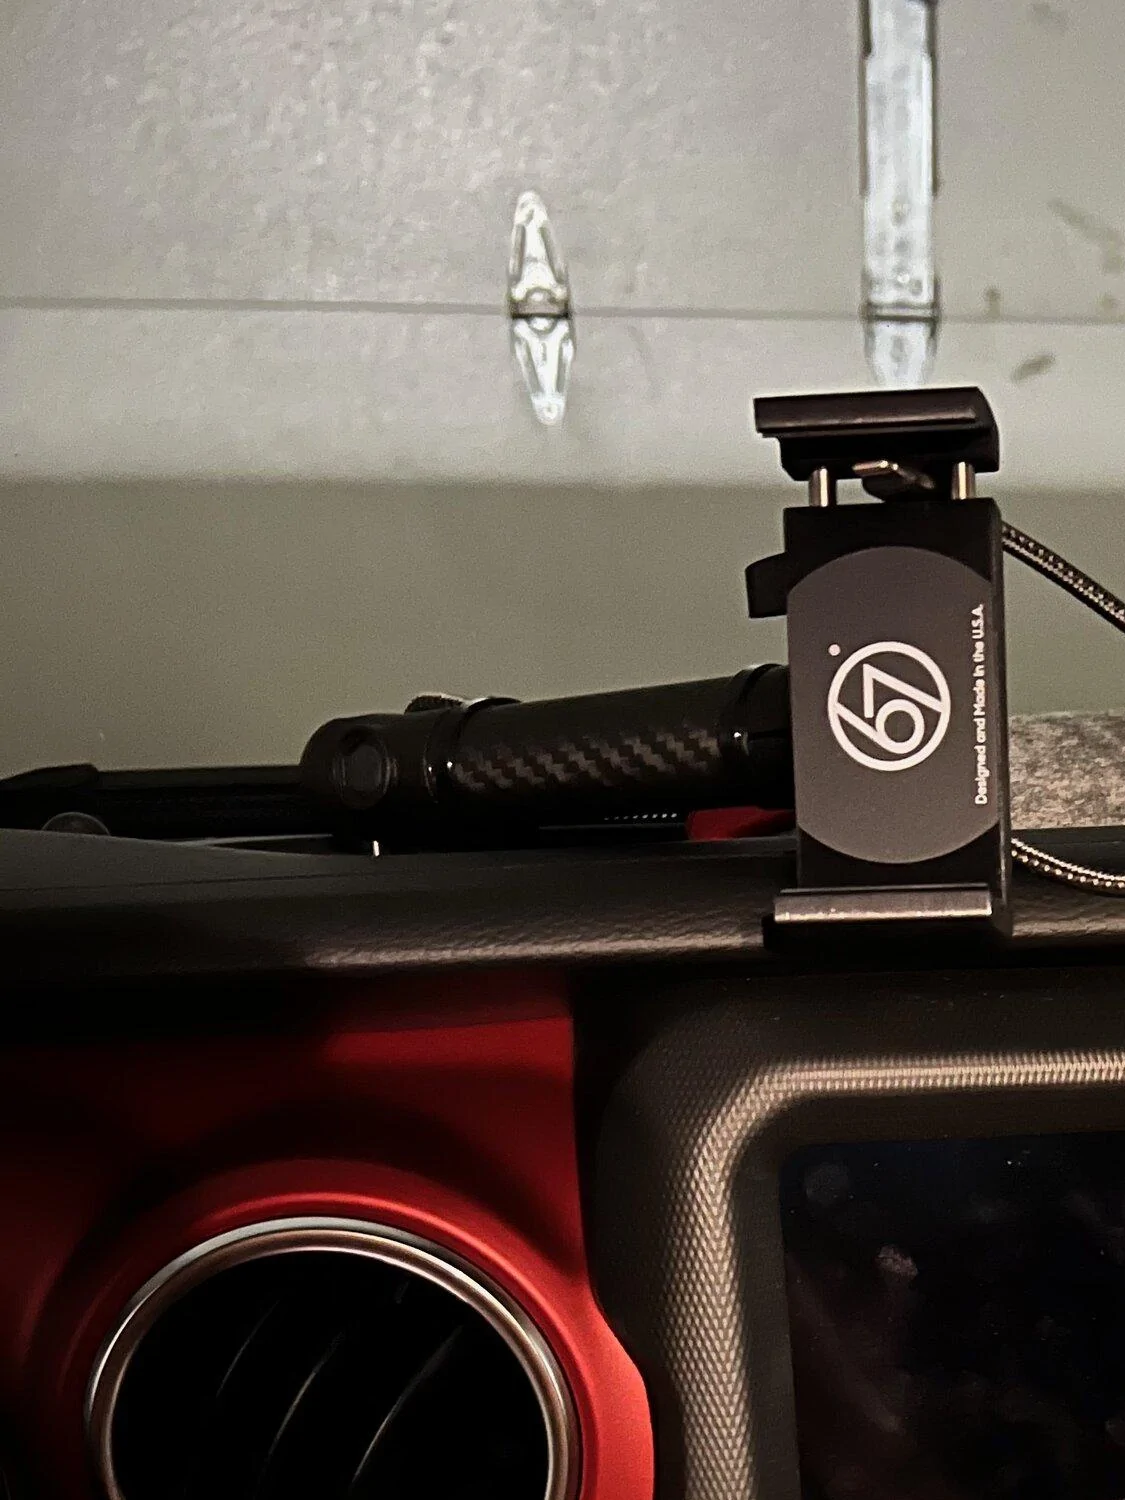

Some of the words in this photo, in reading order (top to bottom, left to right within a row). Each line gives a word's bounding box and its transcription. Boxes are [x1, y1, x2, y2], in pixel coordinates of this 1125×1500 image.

[972, 641, 985, 662] the
[972, 664, 986, 678] in
[973, 678, 987, 716] Made
[973, 717, 987, 743] and
[974, 744, 990, 805] Designed
